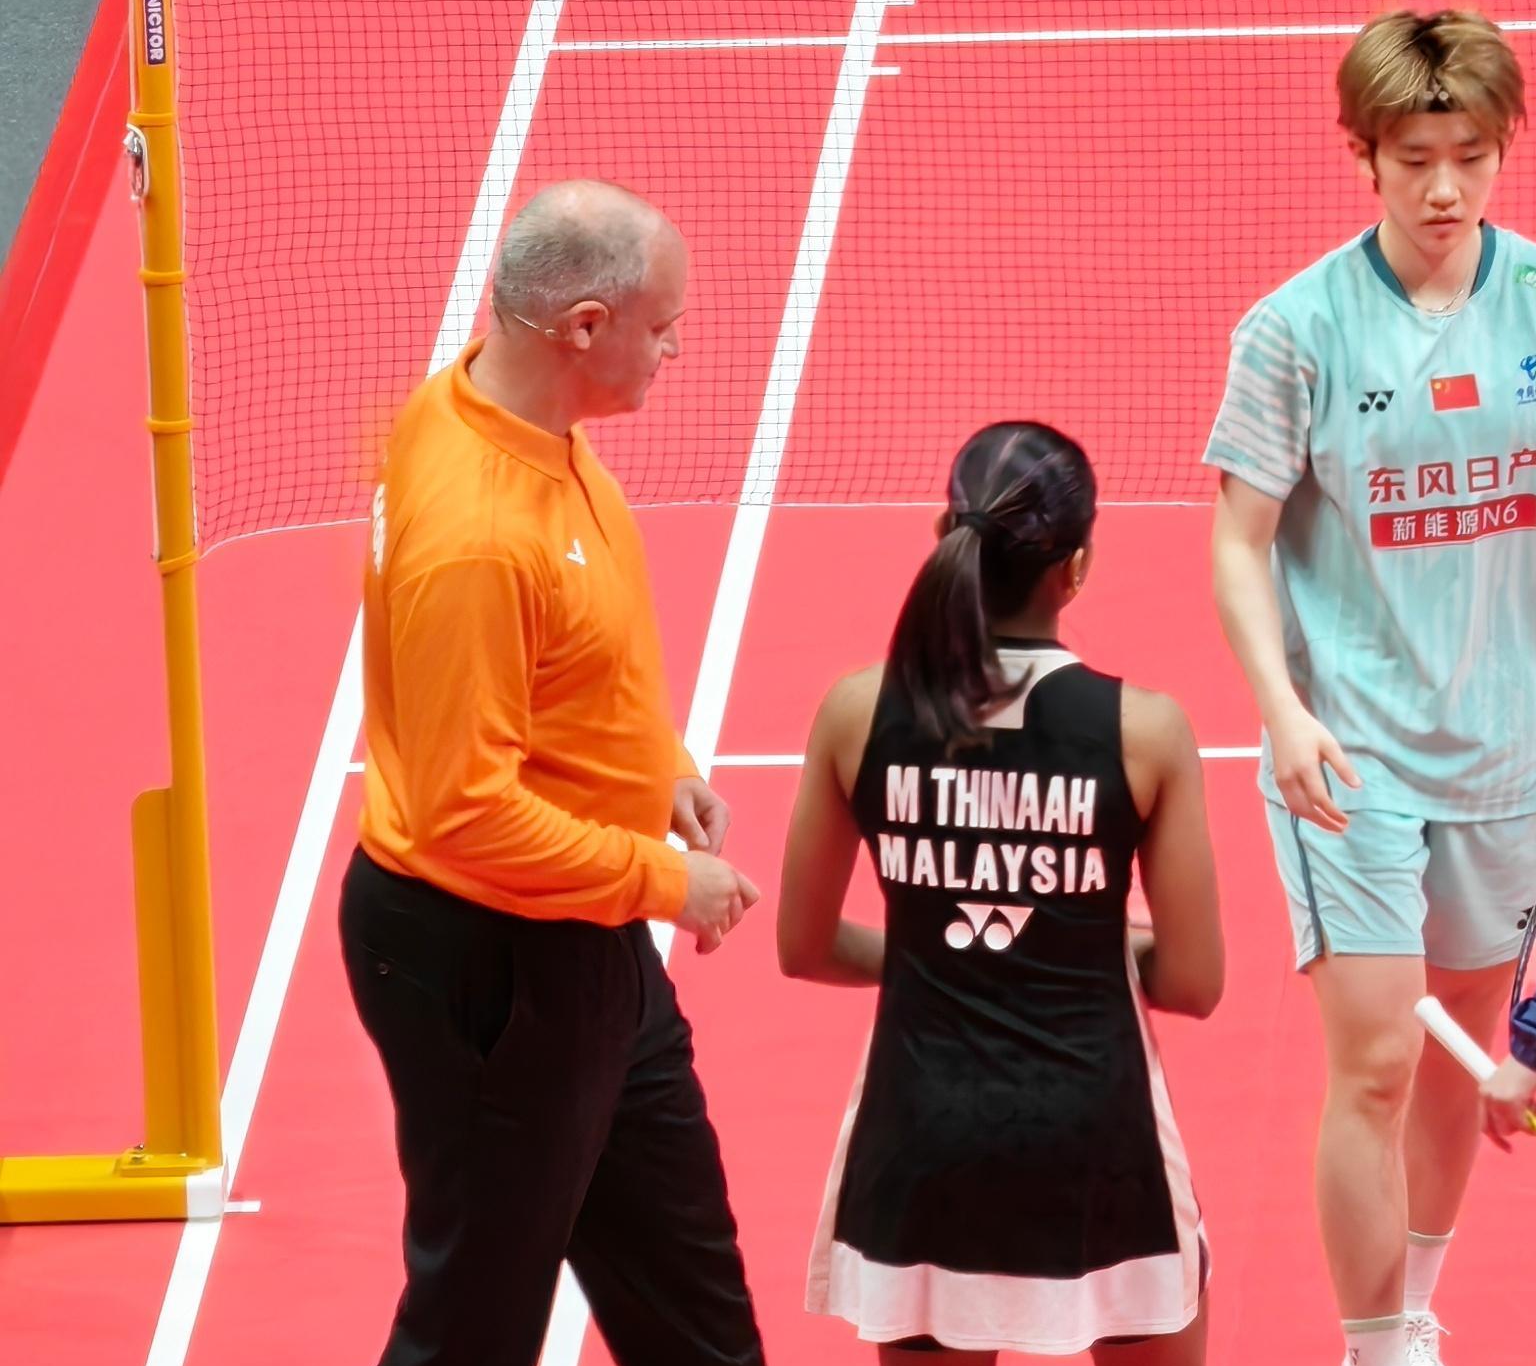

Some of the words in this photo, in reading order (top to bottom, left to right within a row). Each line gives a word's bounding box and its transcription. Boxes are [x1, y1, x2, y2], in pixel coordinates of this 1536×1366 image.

[1392, 504, 1519, 542] 新能源N6
[886, 765, 920, 824] M
[930, 767, 1097, 835] THINAAH
[877, 833, 1107, 894] MALAYSIA
